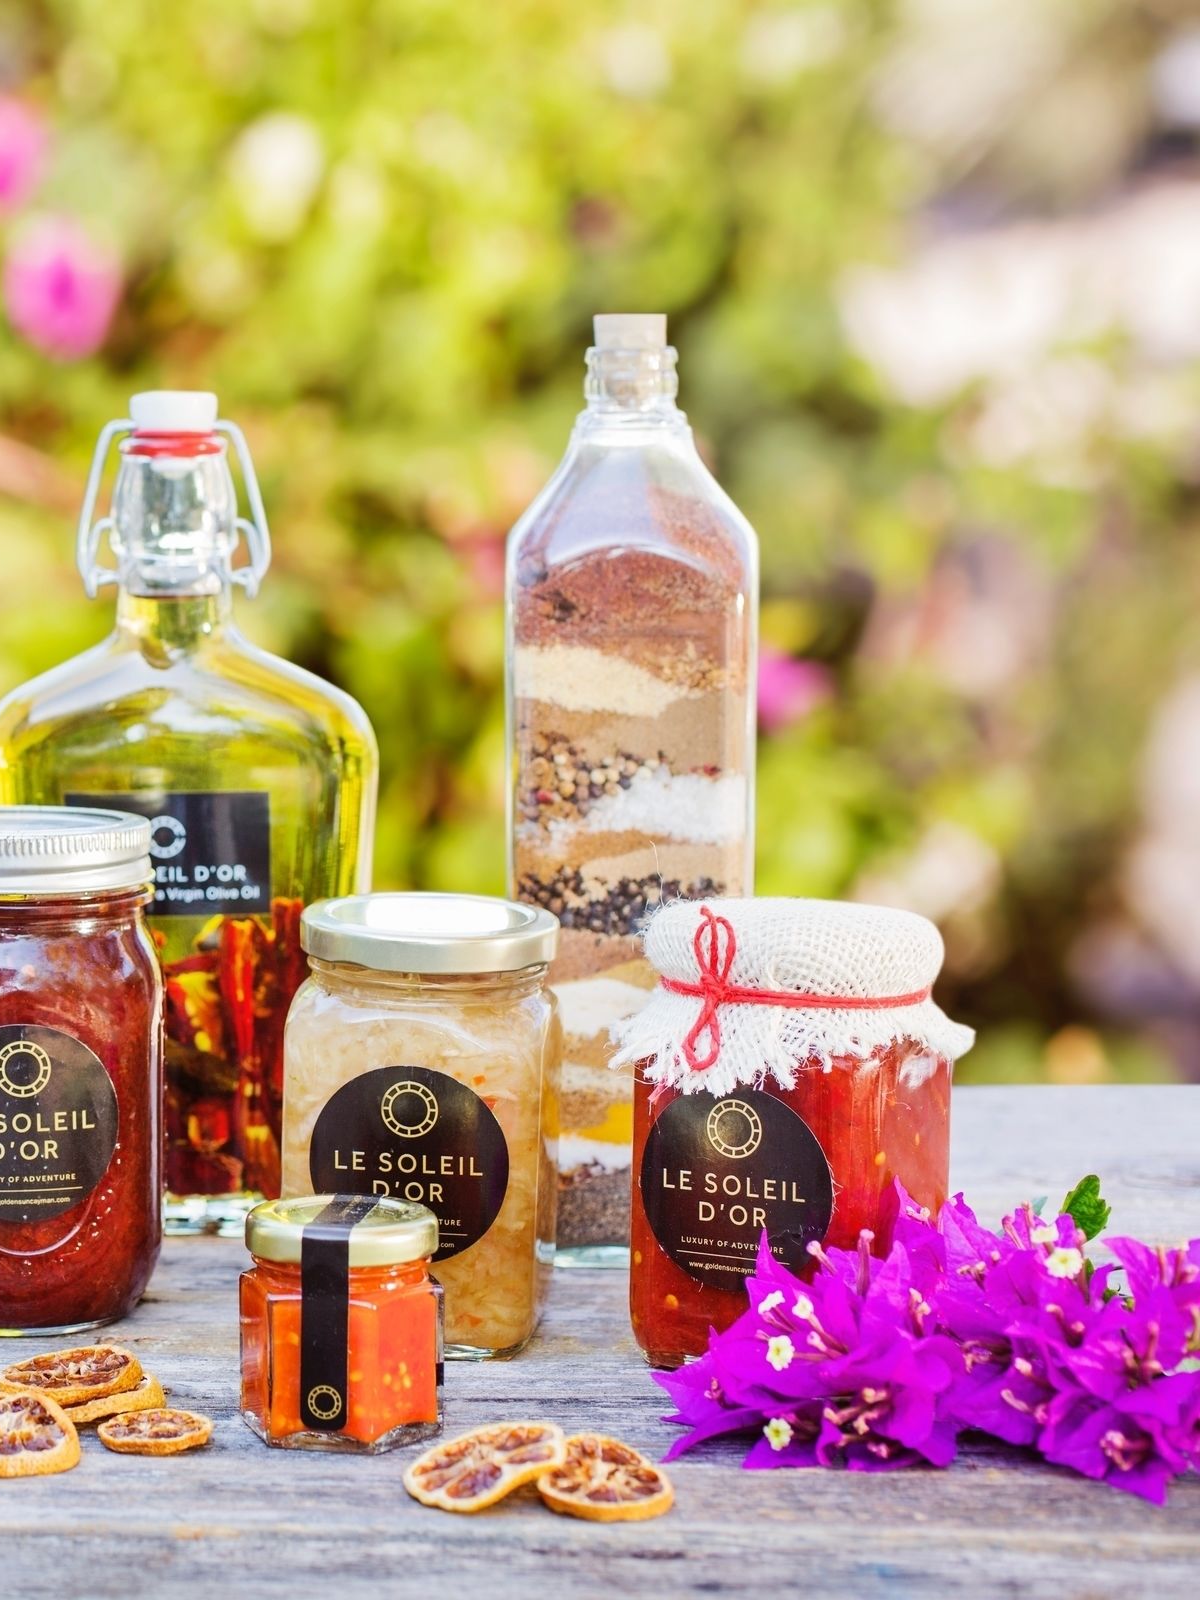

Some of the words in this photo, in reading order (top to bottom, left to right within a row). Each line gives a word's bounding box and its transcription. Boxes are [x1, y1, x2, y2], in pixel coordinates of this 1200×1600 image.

[155, 866, 189, 883] EIL
[194, 864, 247, 883] D'OR
[206, 886, 240, 900] Olive
[241, 885, 261, 900] Oil
[334, 1150, 366, 1171] LE
[378, 1152, 483, 1177] SOLEIL
[8, 1175, 20, 1184] OF
[23, 1173, 76, 1182] ADVENTURE
[663, 1168, 693, 1191] LE
[704, 1172, 806, 1203] SOLEIL
[372, 1179, 444, 1203] D'OR
[698, 1201, 767, 1228] D'OR
[681, 1235, 714, 1246] LUXURY
[717, 1240, 729, 1248] OF
[730, 1242, 785, 1255] ADVENURE
[689, 1260, 758, 1275] www.goldensuncayma
